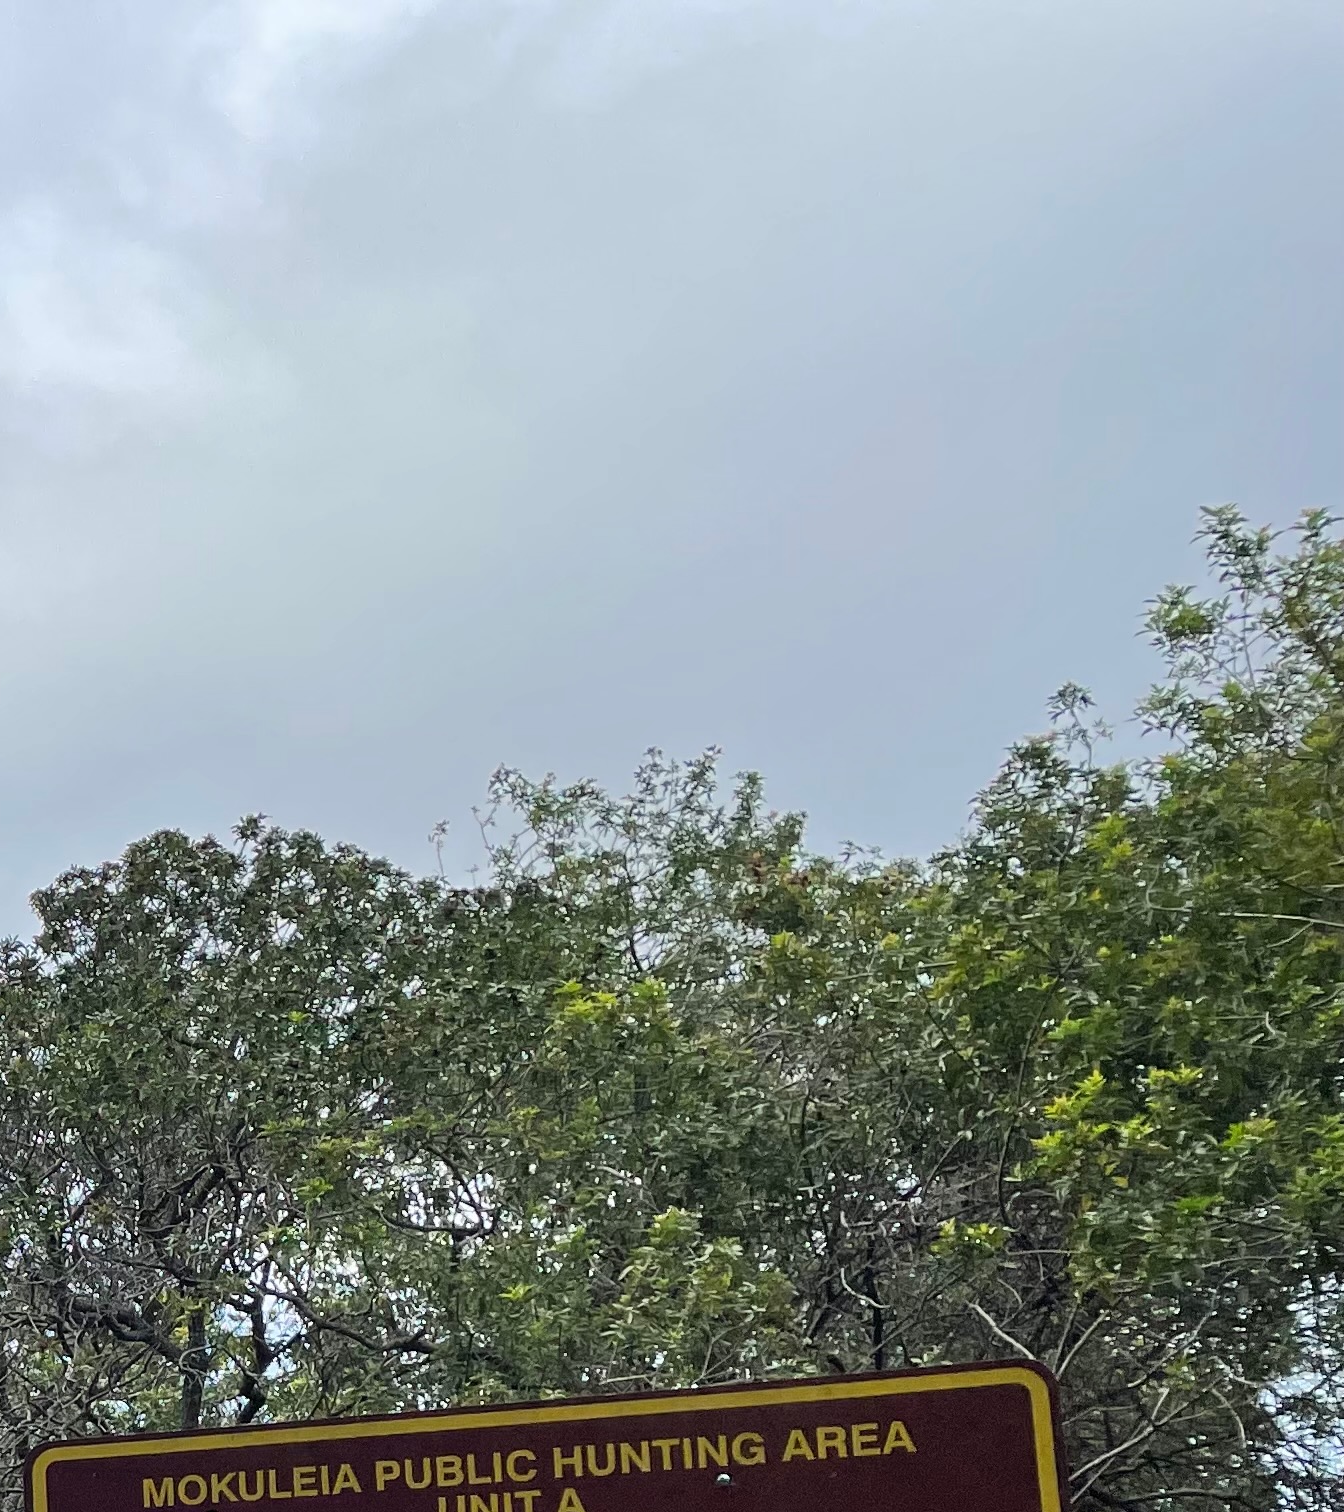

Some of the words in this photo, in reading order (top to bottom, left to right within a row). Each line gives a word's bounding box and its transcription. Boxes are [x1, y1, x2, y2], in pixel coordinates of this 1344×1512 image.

[143, 1464, 361, 1507] MOKULEIA
[376, 1449, 537, 1490] PUBLIC
[553, 1432, 765, 1477] HUNTING
[783, 1421, 916, 1461] AREA
